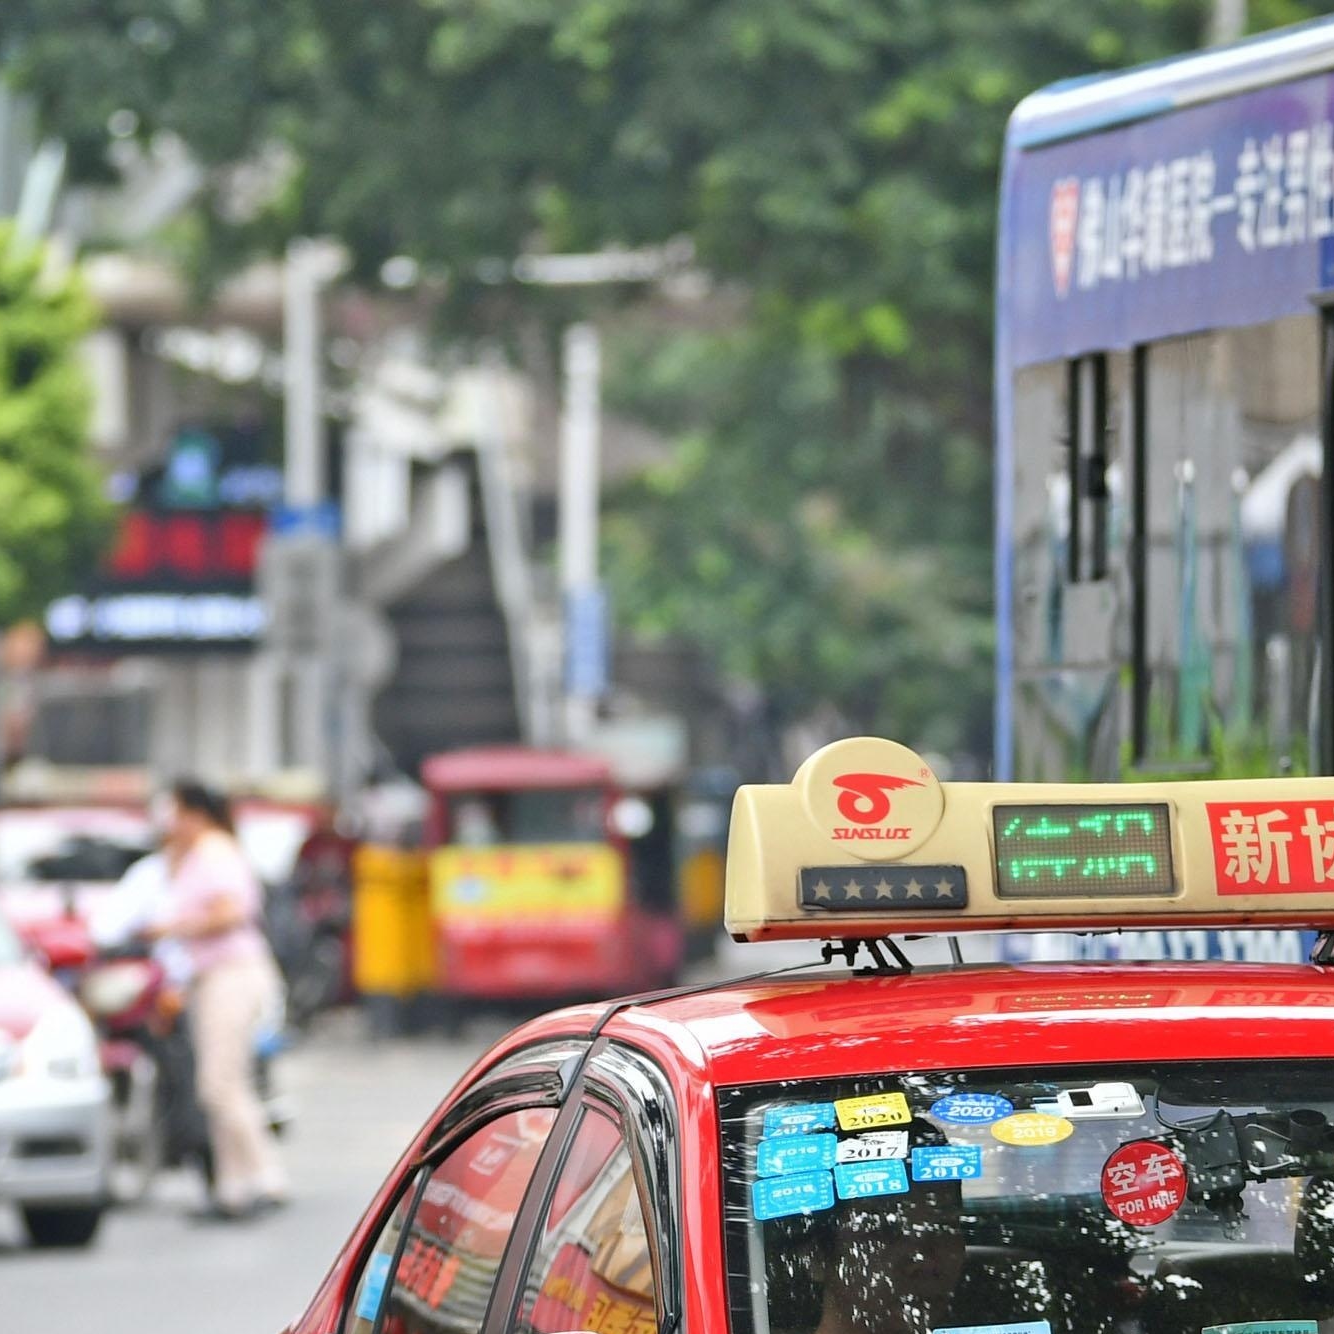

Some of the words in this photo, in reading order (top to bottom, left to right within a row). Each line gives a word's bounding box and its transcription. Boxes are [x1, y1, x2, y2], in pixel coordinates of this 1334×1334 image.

[847, 1111, 903, 1127] 2020
[948, 1106, 996, 1117] 2020
[1012, 1127, 1057, 1139] 2019
[844, 1146, 899, 1159] 2017
[920, 1164, 976, 1180] 2019
[1106, 1152, 1180, 1197] 空车
[845, 1178, 903, 1196] 2018
[1117, 1198, 1145, 1217] FOR
[1148, 1190, 1179, 1211] HIRE
